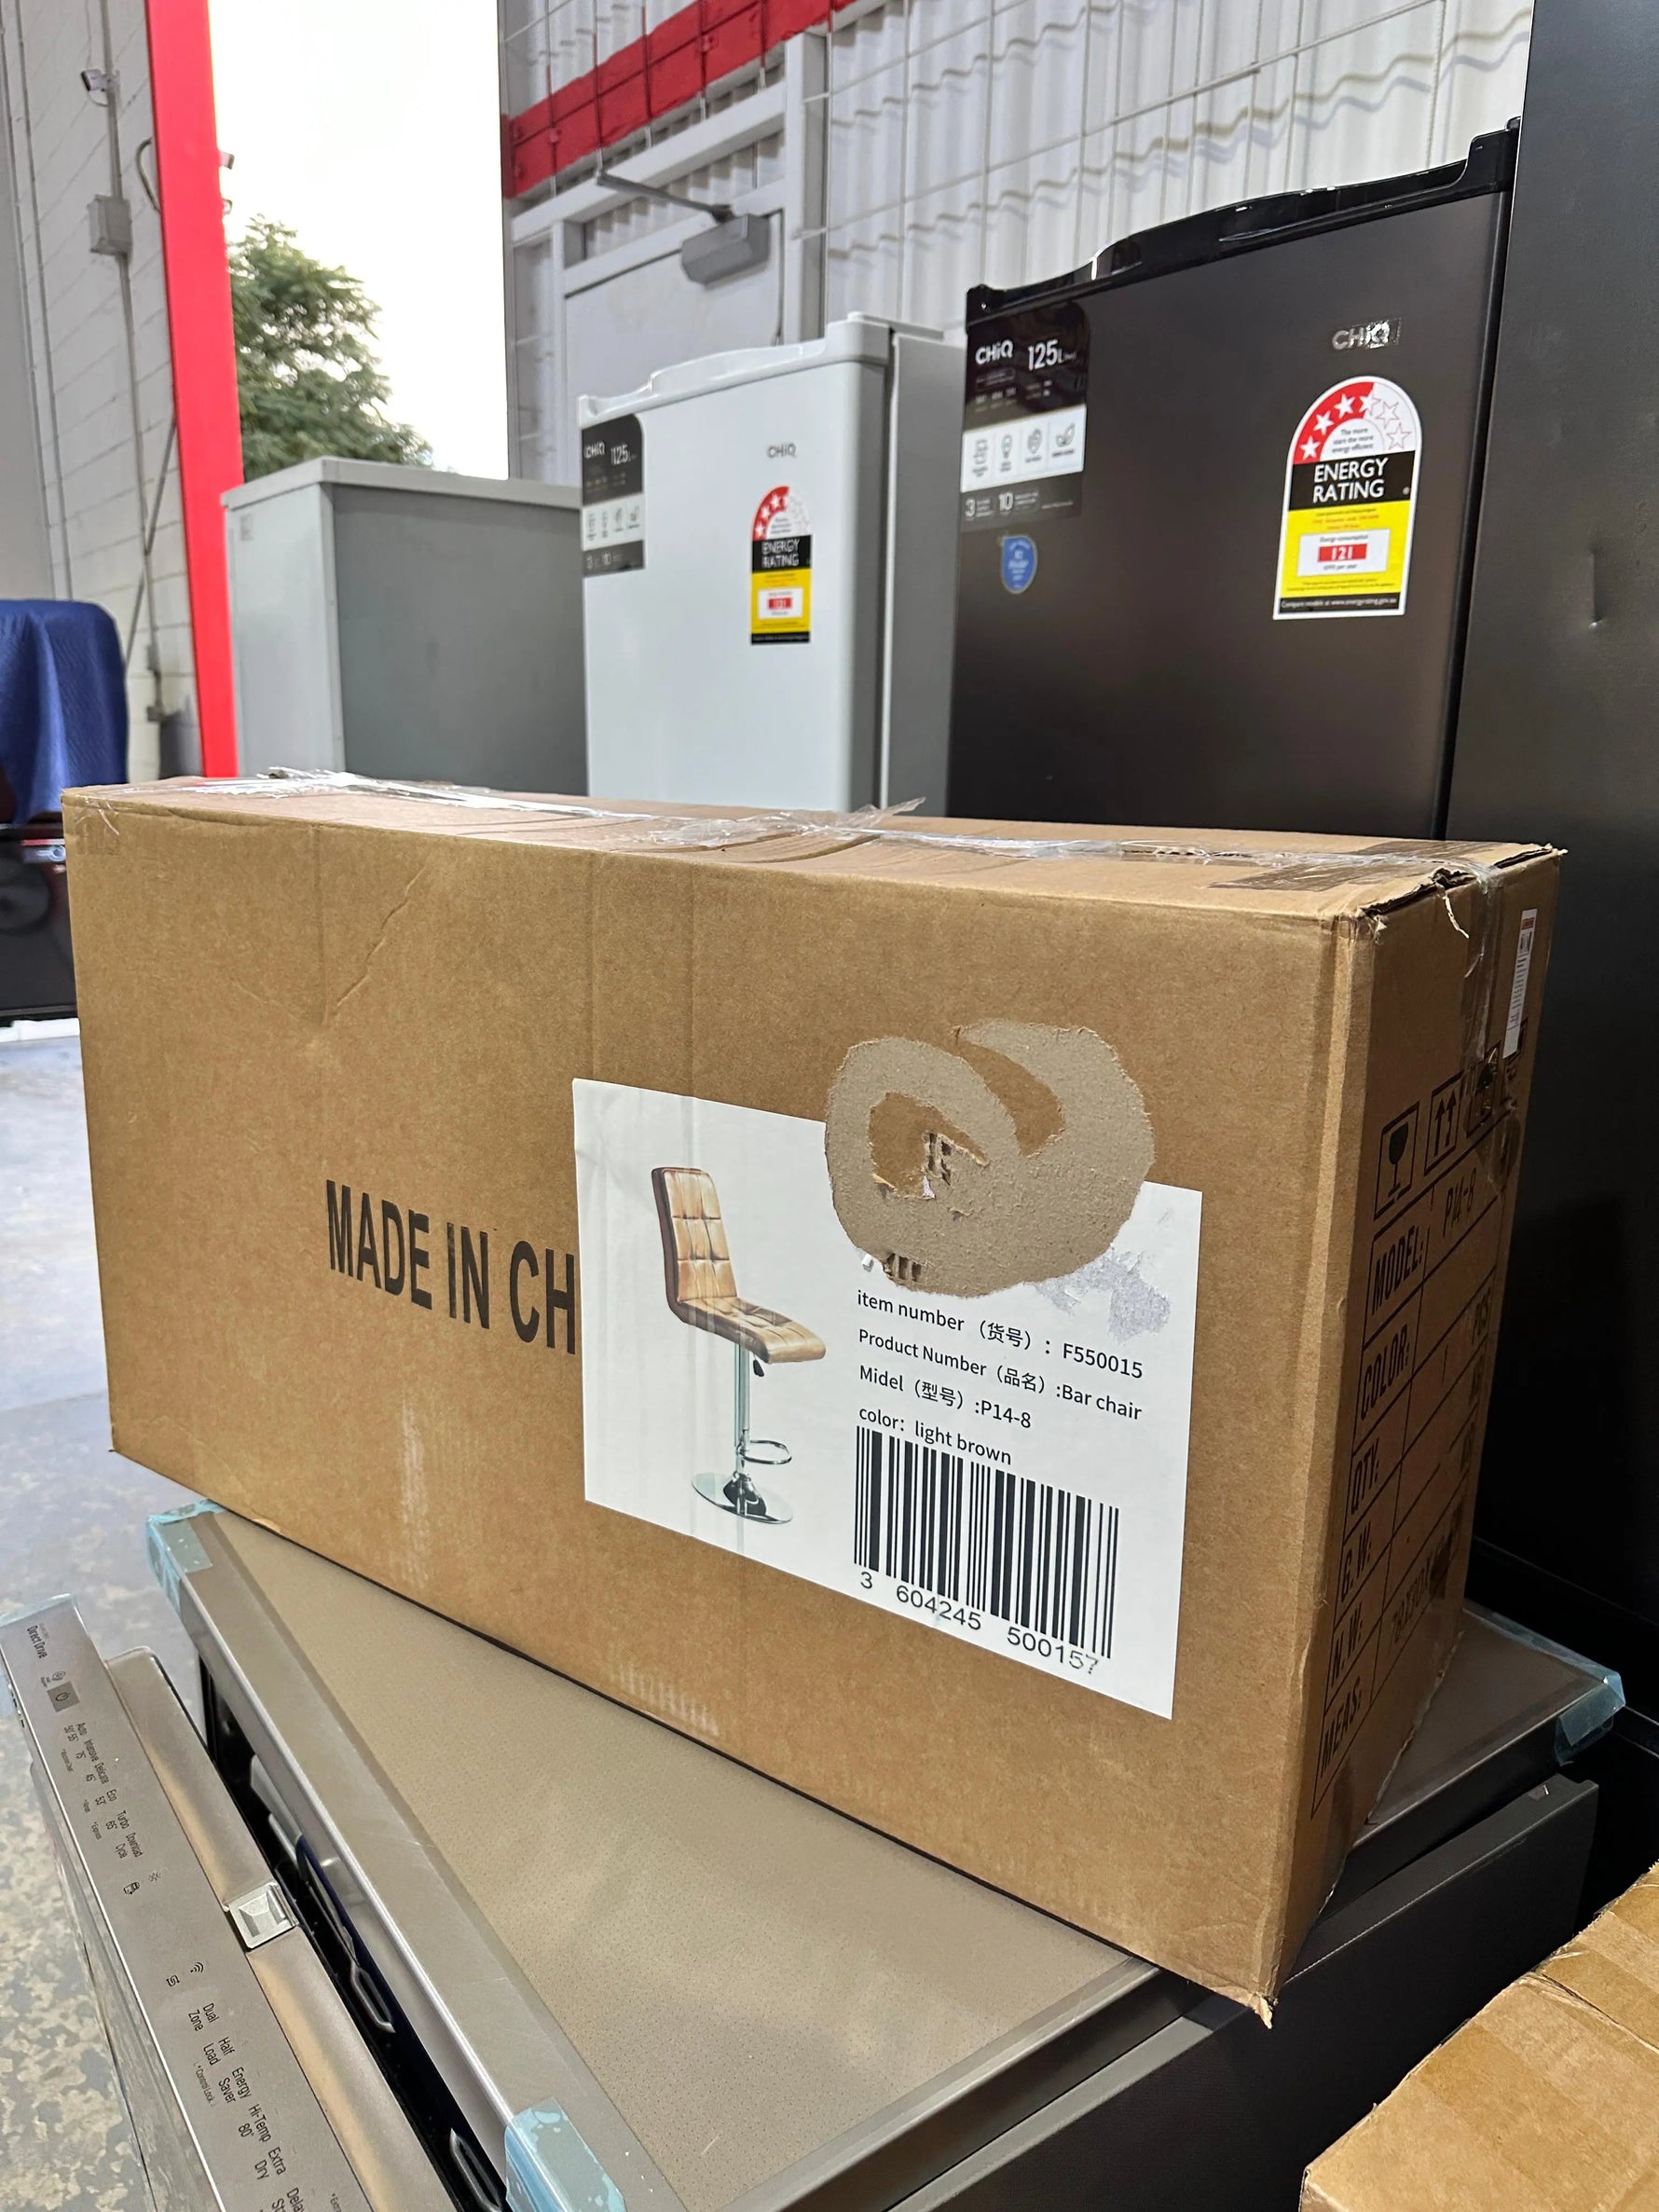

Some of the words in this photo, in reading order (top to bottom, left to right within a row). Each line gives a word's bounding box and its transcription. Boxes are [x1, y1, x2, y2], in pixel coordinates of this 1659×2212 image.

[1314, 457, 1389, 483] ENERGY
[1313, 479, 1385, 503] RATING
[761, 540, 801, 556] ENERGY
[1331, 546, 1354, 560] 121
[761, 553, 800, 569] RATING
[326, 1179, 432, 1310] MADE
[446, 1222, 490, 1329] IN
[1372, 1224, 1424, 1316] MODEL:
[857, 1290, 894, 1313] item
[898, 1302, 965, 1331] number
[1063, 1342, 1144, 1379] F550015
[858, 1328, 919, 1357] Product
[923, 1346, 987, 1376] Number
[1096, 1395, 1143, 1421] chair
[859, 1365, 904, 1392] Midel
[1361, 1323, 1411, 1422] COLOR:
[914, 1420, 953, 1447] light
[957, 1431, 1012, 1464] brown
[1351, 1437, 1379, 1516] QTY:
[27, 1625, 42, 1644] Direct
[860, 1572, 873, 1590] 3
[896, 1585, 982, 1631] 604245
[1007, 1626, 1100, 1675] 500157
[34, 1642, 48, 1658] Drive
[76, 1723, 88, 1736] Auto
[84, 1738, 99, 1762] Intensive
[94, 1762, 109, 1784] Delicate
[106, 1789, 117, 1802] Eco
[117, 1809, 130, 1830] Turbo
[188, 2009, 204, 2032] Zone
[203, 2002, 220, 2024] Dual
[203, 2042, 221, 2066] Load
[218, 2036, 235, 2056] Half
[218, 2077, 236, 2104] Saver
[231, 2067, 252, 2099] Energy
[248, 2103, 272, 2143] Hi-Temp
[254, 2159, 269, 2180] Dry
[268, 2147, 286, 2176] Extra
[287, 2187, 305, 2212] Dela
